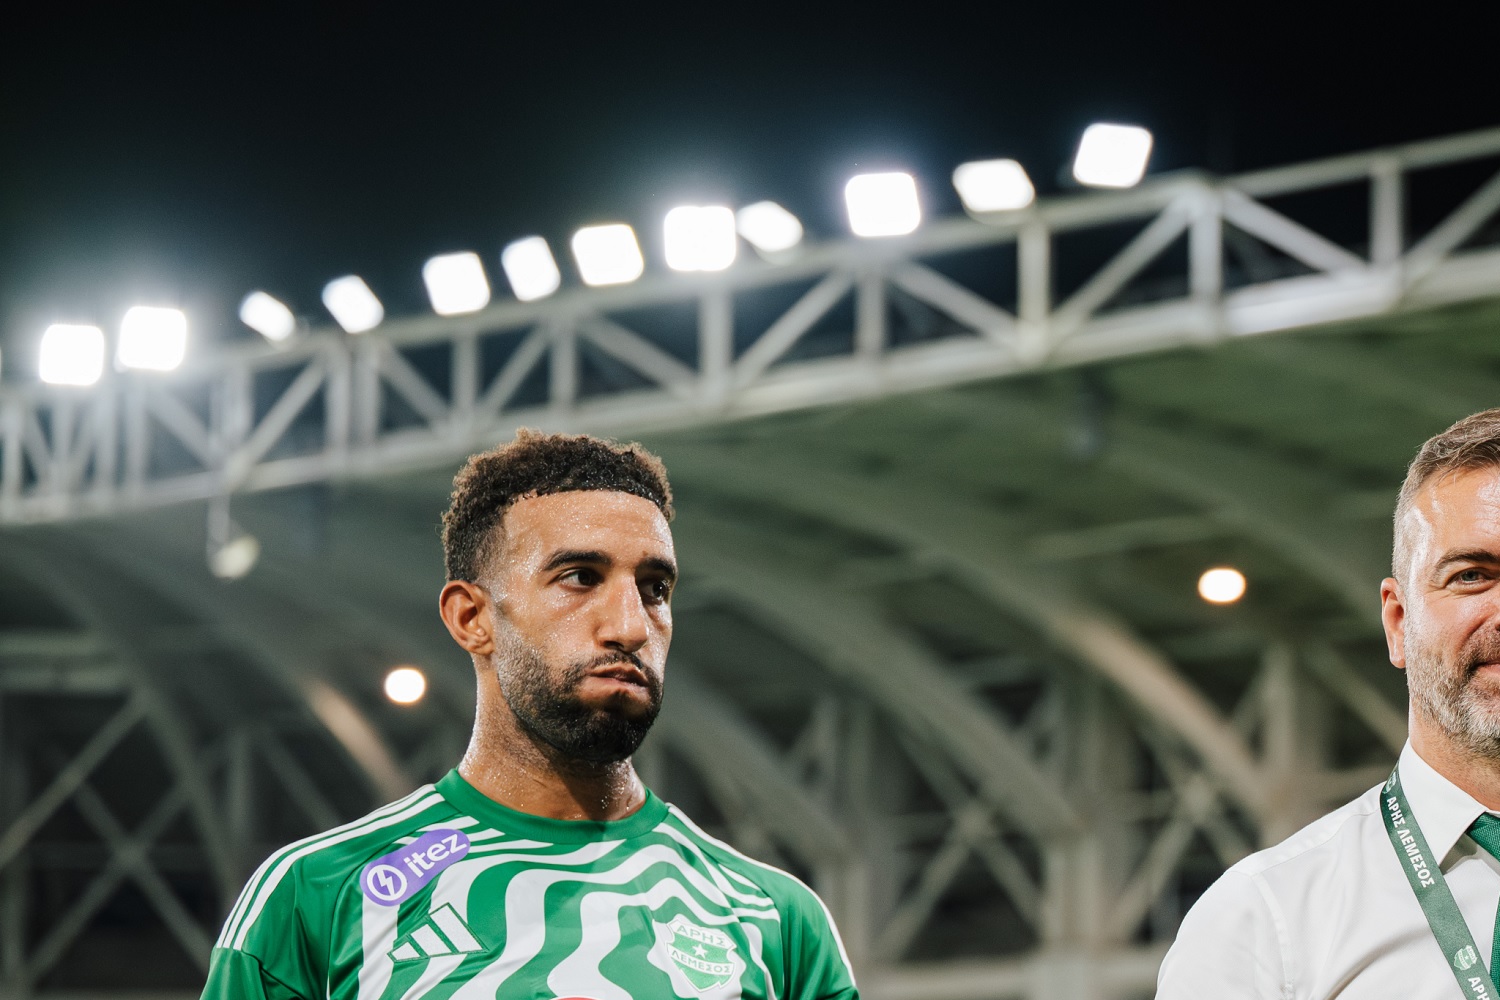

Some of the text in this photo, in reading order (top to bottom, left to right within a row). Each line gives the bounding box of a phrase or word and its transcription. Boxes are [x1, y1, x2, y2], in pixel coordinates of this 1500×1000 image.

[403, 833, 468, 878] itez
[1386, 796, 1435, 888] ΑΡΗΣ ΛΕΜΕΣΟΣ
[676, 924, 726, 947] ΑΡΗΣ
[671, 949, 731, 974] ΛΕΜΕΣΟΣ
